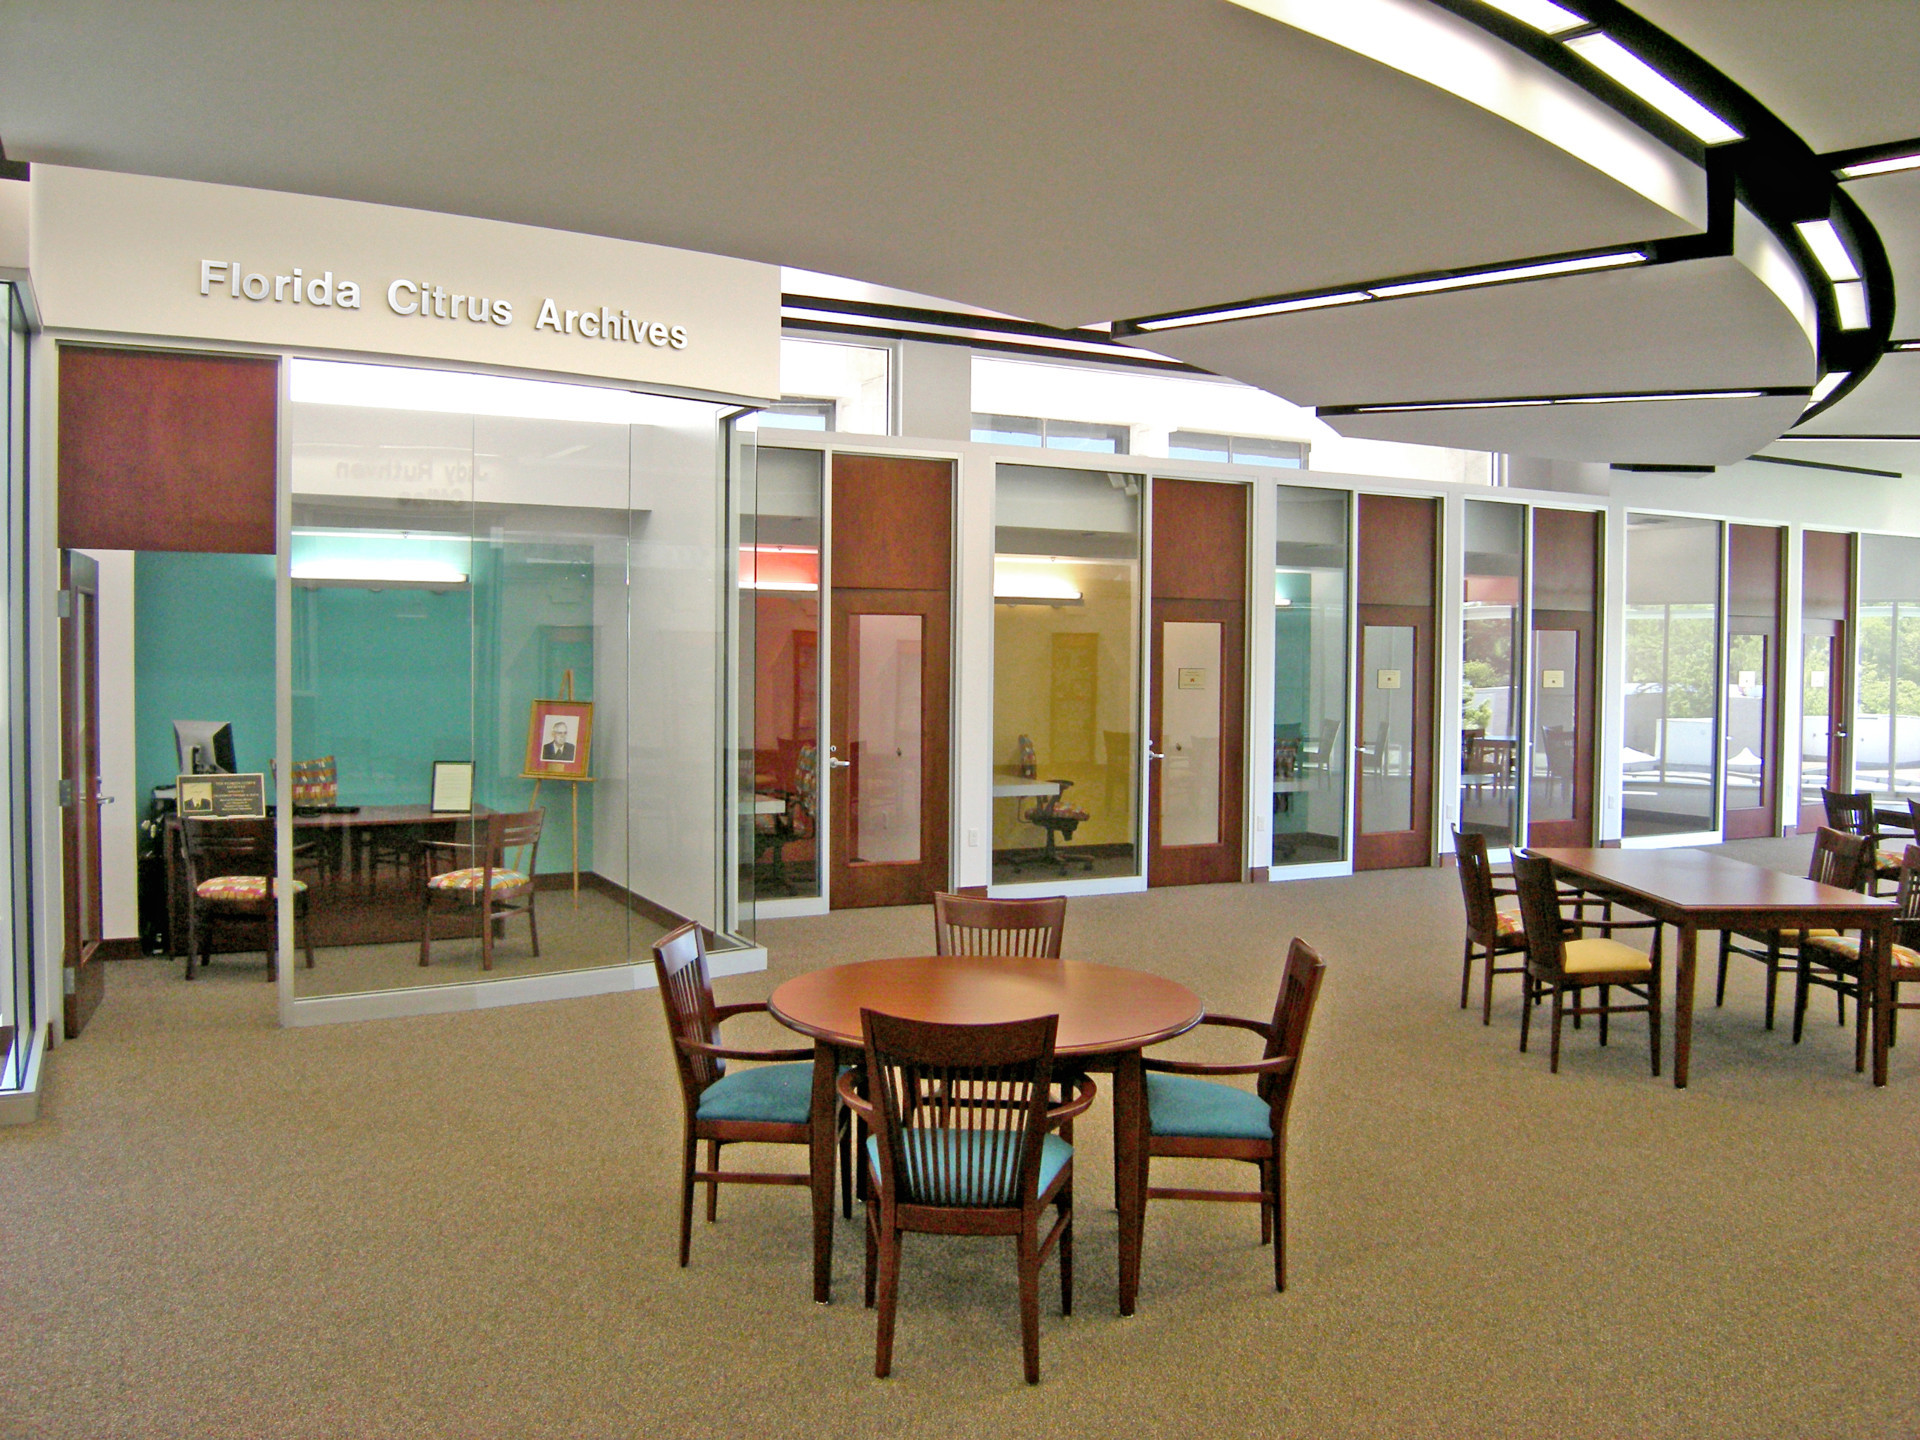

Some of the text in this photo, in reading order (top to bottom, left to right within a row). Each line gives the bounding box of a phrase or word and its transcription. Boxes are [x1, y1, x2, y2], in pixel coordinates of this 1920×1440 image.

[200, 259, 689, 350] Florida Citrus Archives
